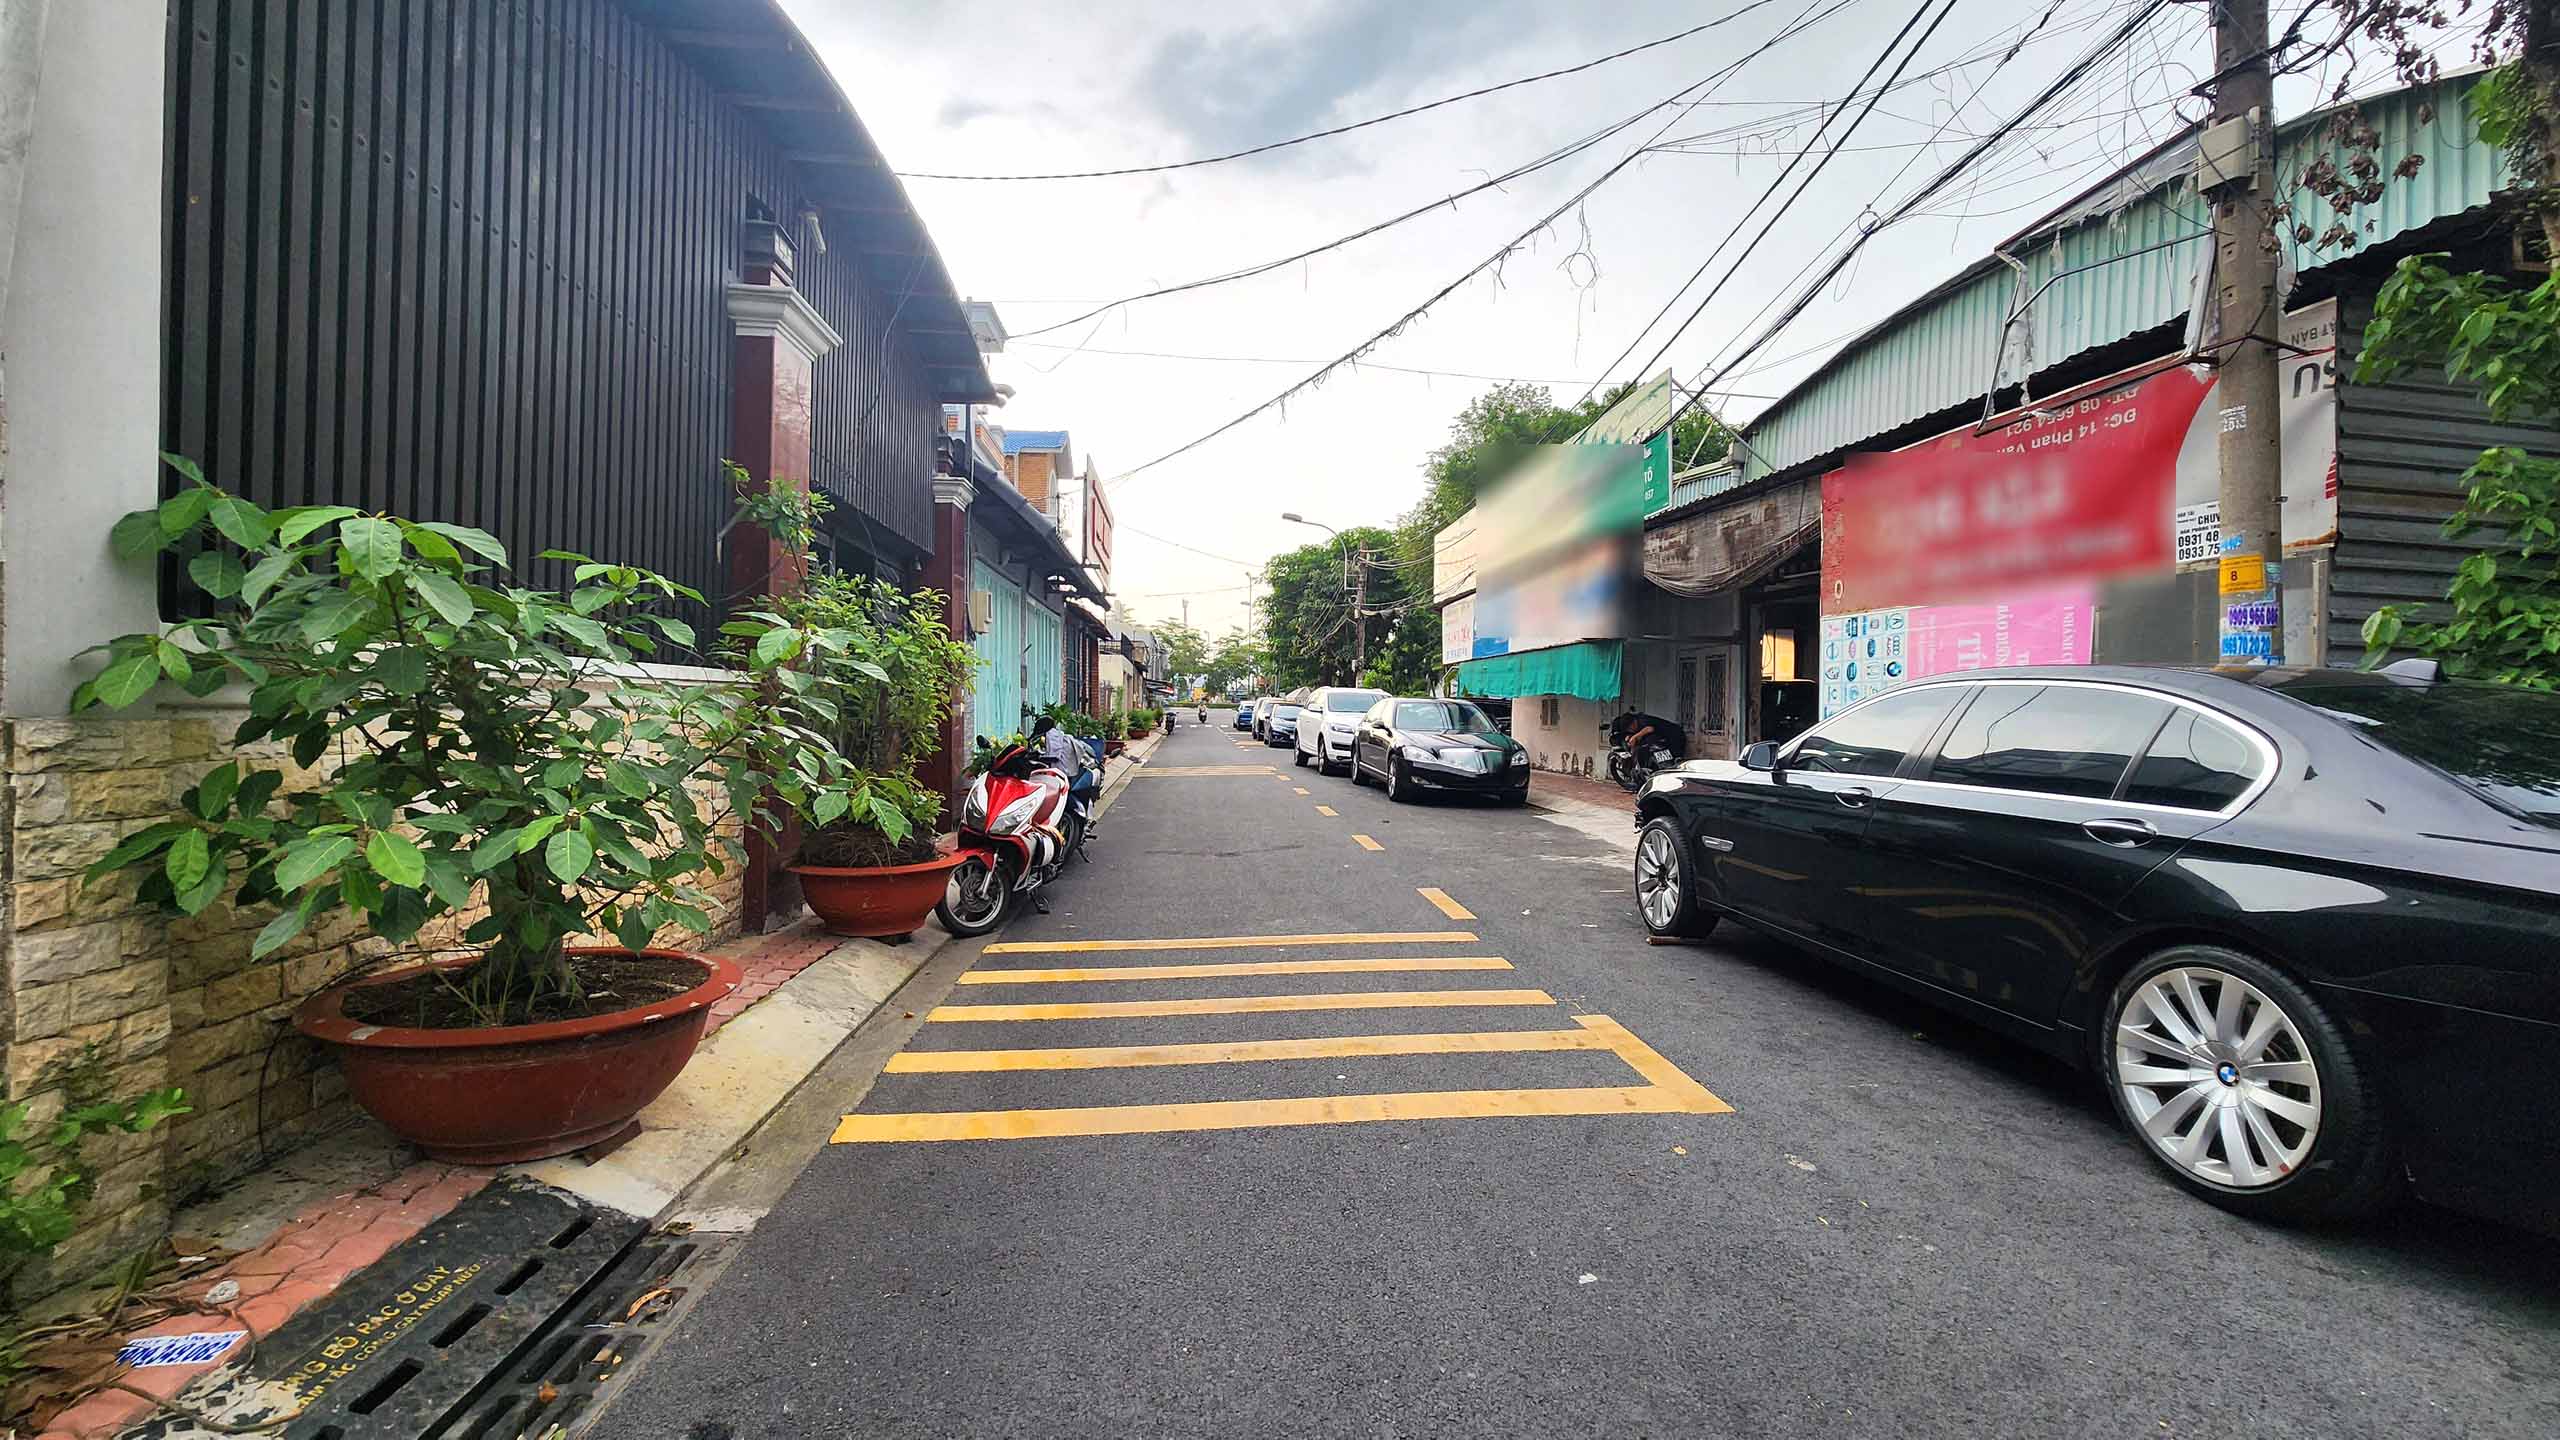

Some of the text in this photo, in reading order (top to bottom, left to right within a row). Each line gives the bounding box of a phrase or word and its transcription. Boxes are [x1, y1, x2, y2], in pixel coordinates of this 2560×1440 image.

[2079, 398, 2101, 415] 08
[2103, 408, 2137, 428] ĐC:
[2006, 418, 2032, 437] 921
[2079, 422, 2097, 438] 14
[2031, 429, 2073, 449] Phan
[2178, 533, 2202, 547] 0931
[2205, 530, 2219, 542] 48
[2179, 543, 2220, 560] 0933 75
[2230, 570, 2238, 581] 8
